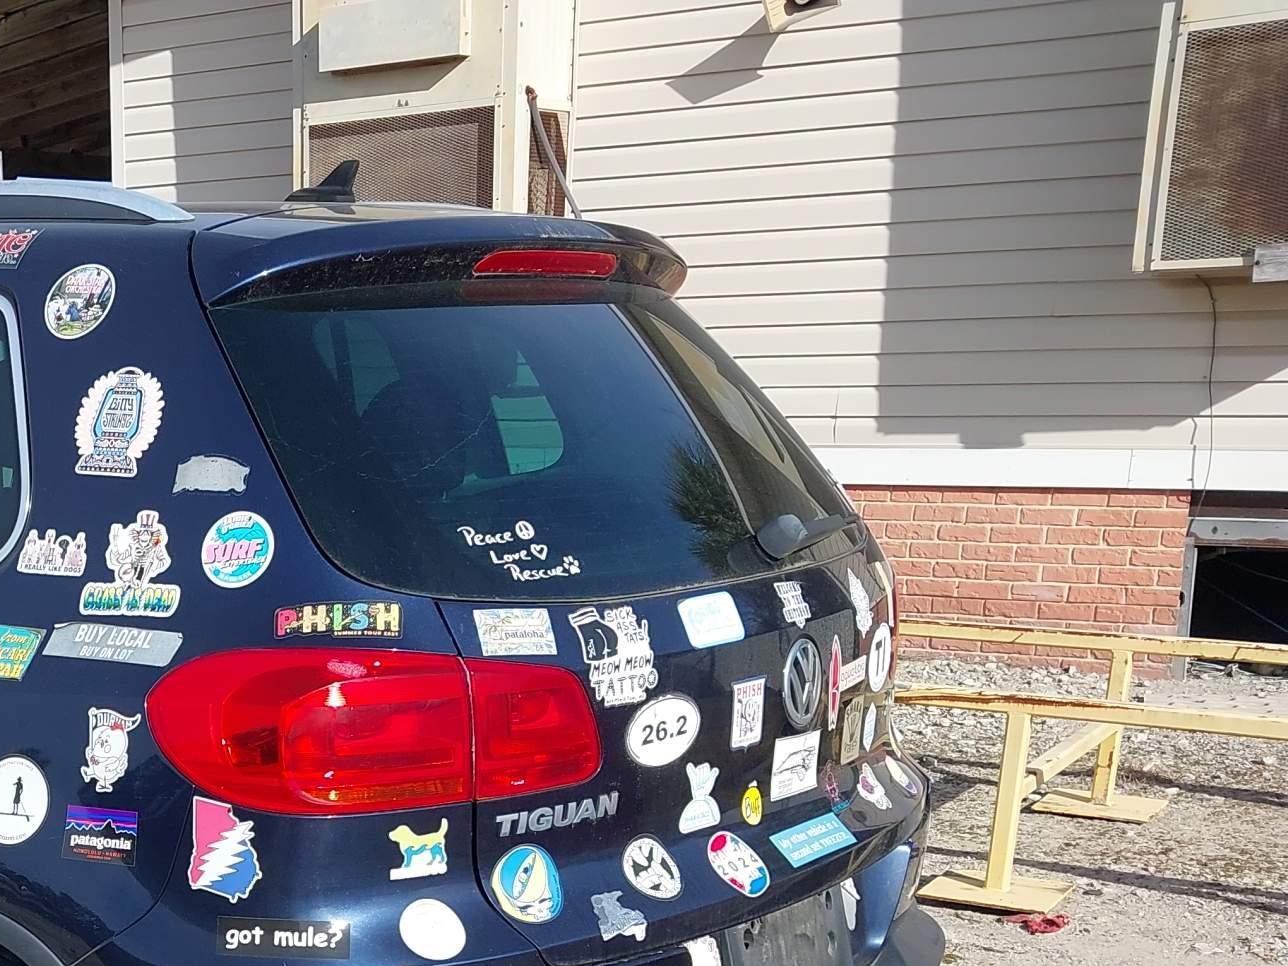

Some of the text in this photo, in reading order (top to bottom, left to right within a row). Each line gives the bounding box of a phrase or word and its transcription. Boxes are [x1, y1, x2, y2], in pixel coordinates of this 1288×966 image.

[457, 526, 513, 546] Peace
[204, 538, 264, 564] SURF
[489, 550, 531, 564] Love
[504, 564, 568, 581] Rescue
[276, 602, 400, 636] PHISH
[606, 607, 635, 622] SICK
[74, 624, 153, 649] BUY LOCAL
[504, 630, 544, 640] pataloha
[617, 621, 637, 632] ASS
[624, 620, 649, 643] TATS!
[79, 645, 135, 660] BUY ON LOT
[592, 655, 652, 677] MEOW MEOW
[592, 670, 657, 700] TATTOO
[736, 682, 763, 699] PHISH
[641, 715, 688, 746] 26.2
[496, 790, 620, 838] TIGUAN
[69, 834, 132, 850] patagonia
[777, 839, 793, 849] My
[716, 852, 760, 876] 2024
[225, 925, 344, 950] got mule?
